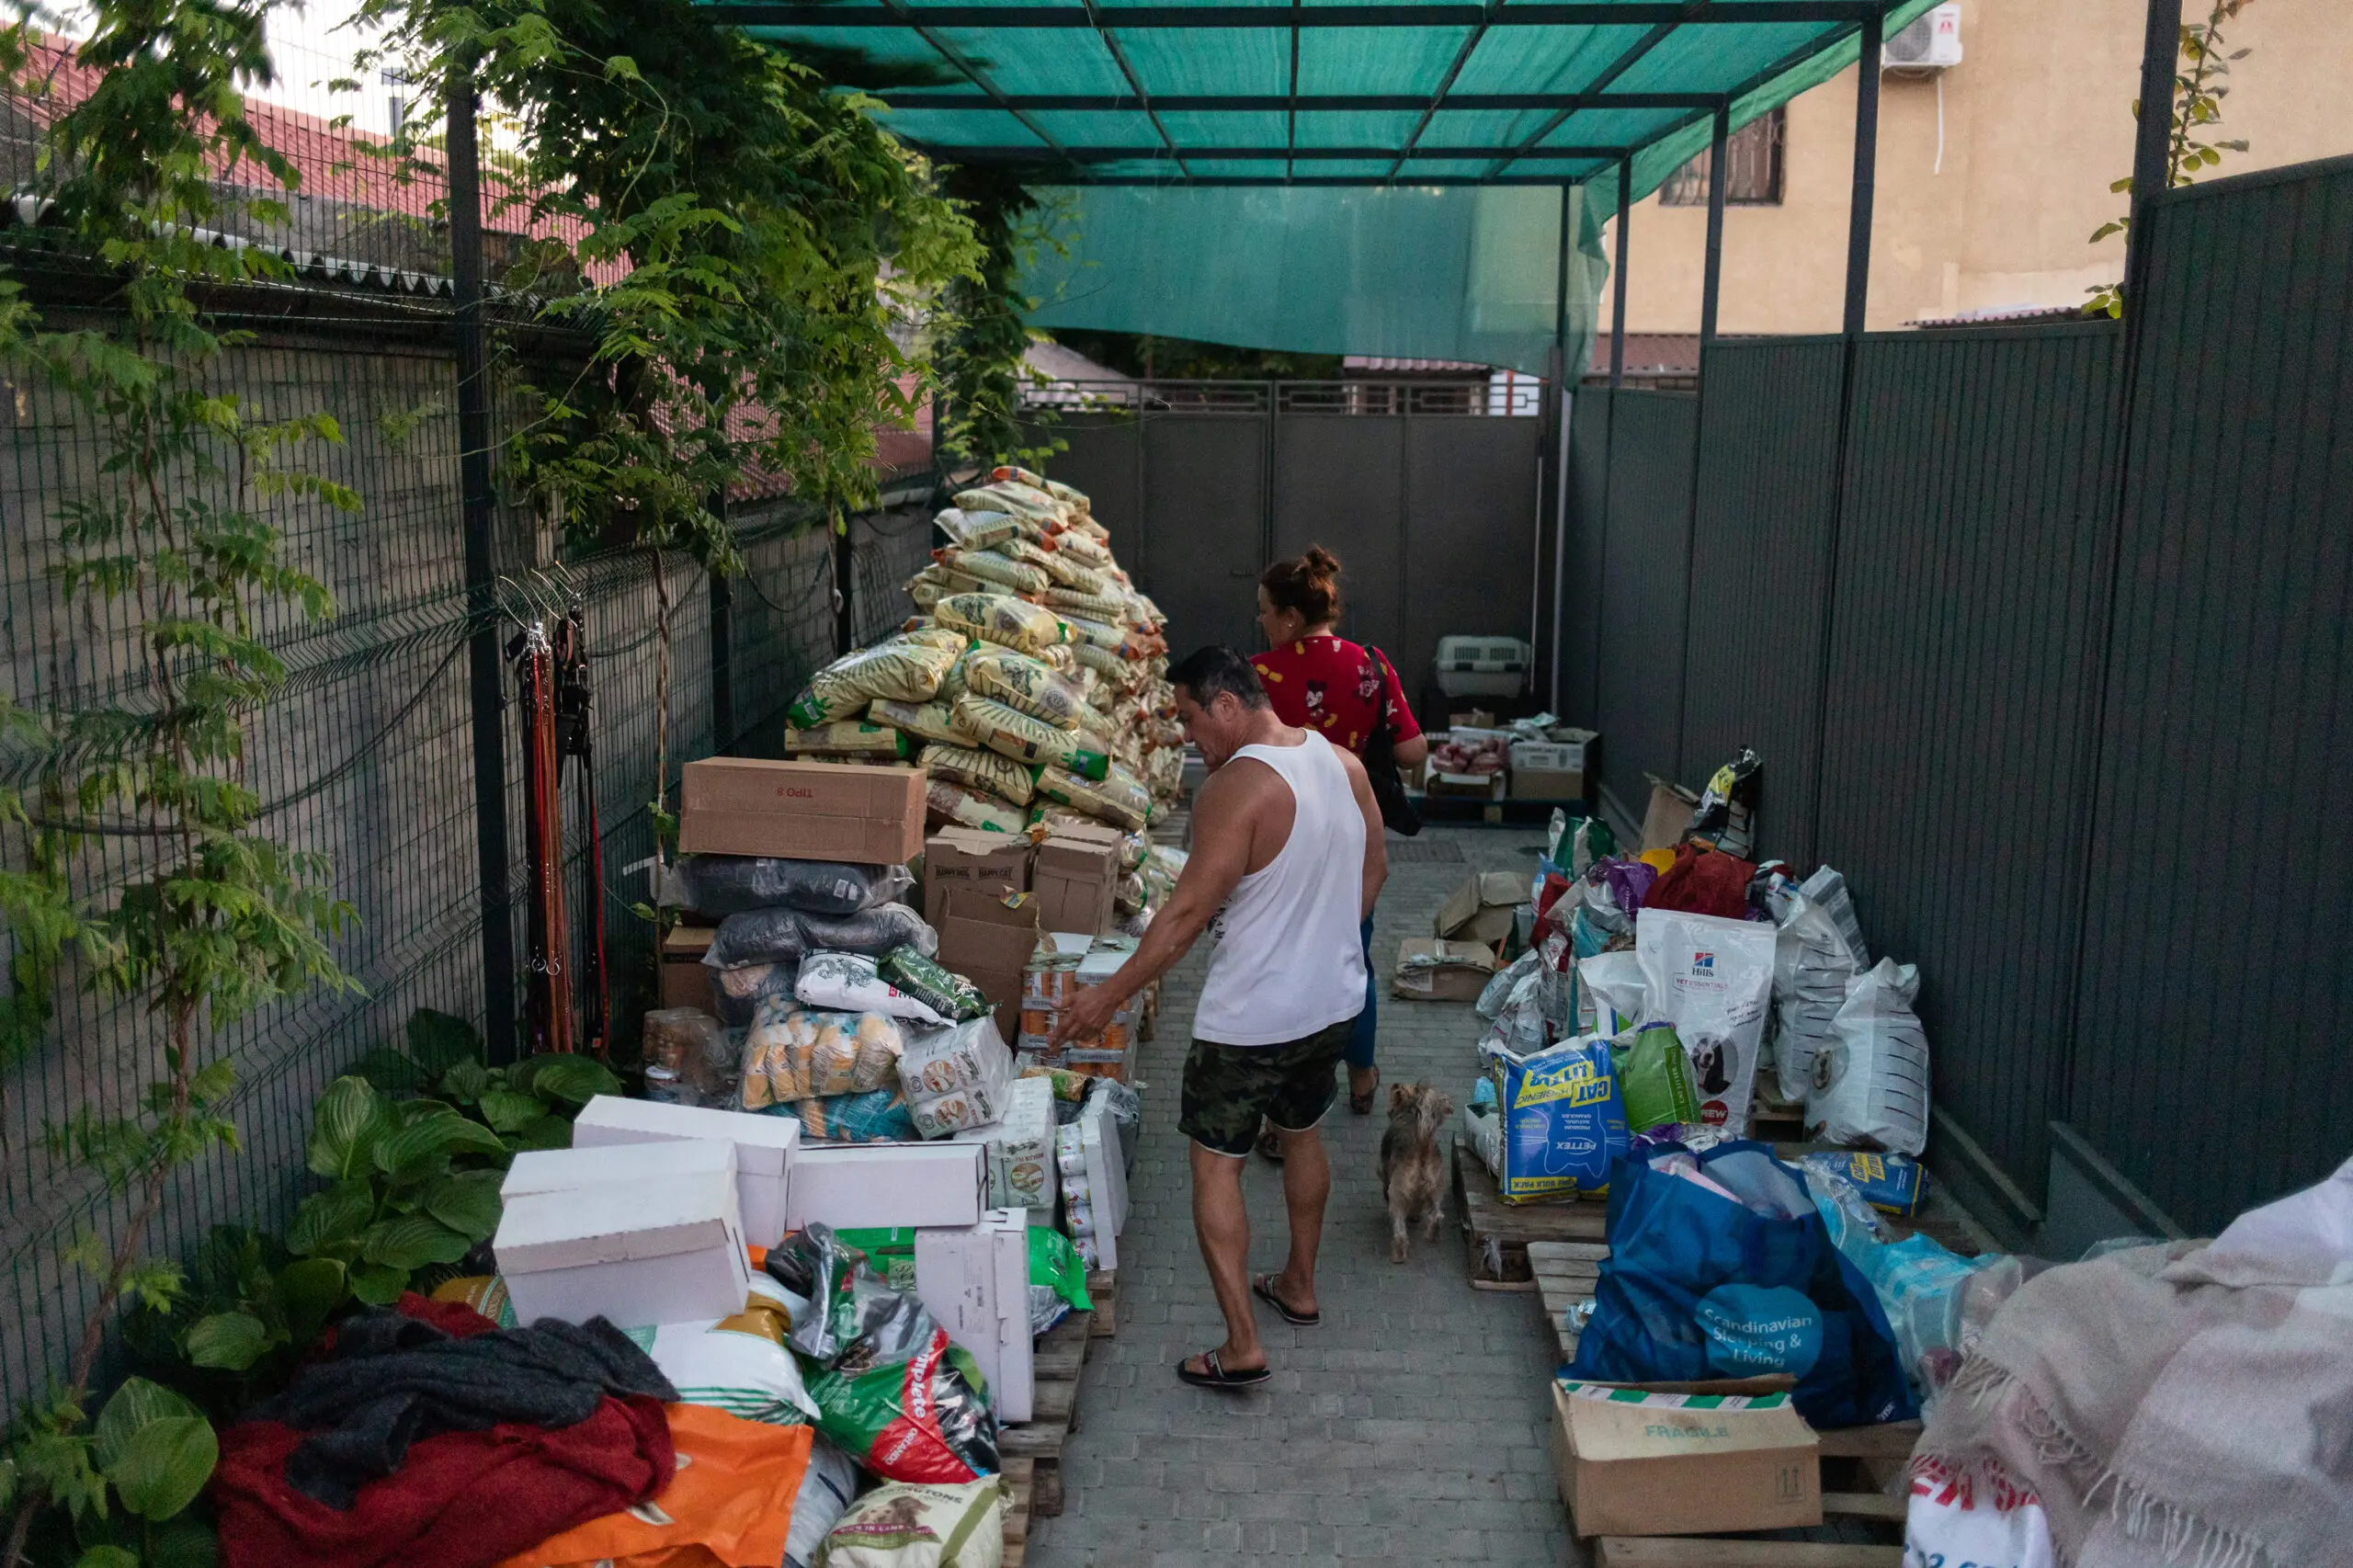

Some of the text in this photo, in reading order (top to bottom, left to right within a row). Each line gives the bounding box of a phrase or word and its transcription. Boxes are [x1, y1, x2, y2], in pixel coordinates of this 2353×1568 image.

[787, 788, 813, 798] TIPO
[978, 868, 1012, 880] HAPPY CAT
[1692, 967, 1714, 977] Hill's
[1689, 981, 1729, 989] ESSENTIALS
[1574, 1080, 1608, 1103] CAT
[1700, 1108, 1727, 1119] NEW
[1555, 1142, 1597, 1151] PETTEX
[1513, 1181, 1534, 1189] PACK
[1704, 1309, 1813, 1334] Scandinavian
[1790, 1334, 1802, 1348] &
[1733, 1348, 1785, 1368] Living
[1644, 1425, 1729, 1437] FRAGILE
[885, 1427, 918, 1465] ORLANDO
